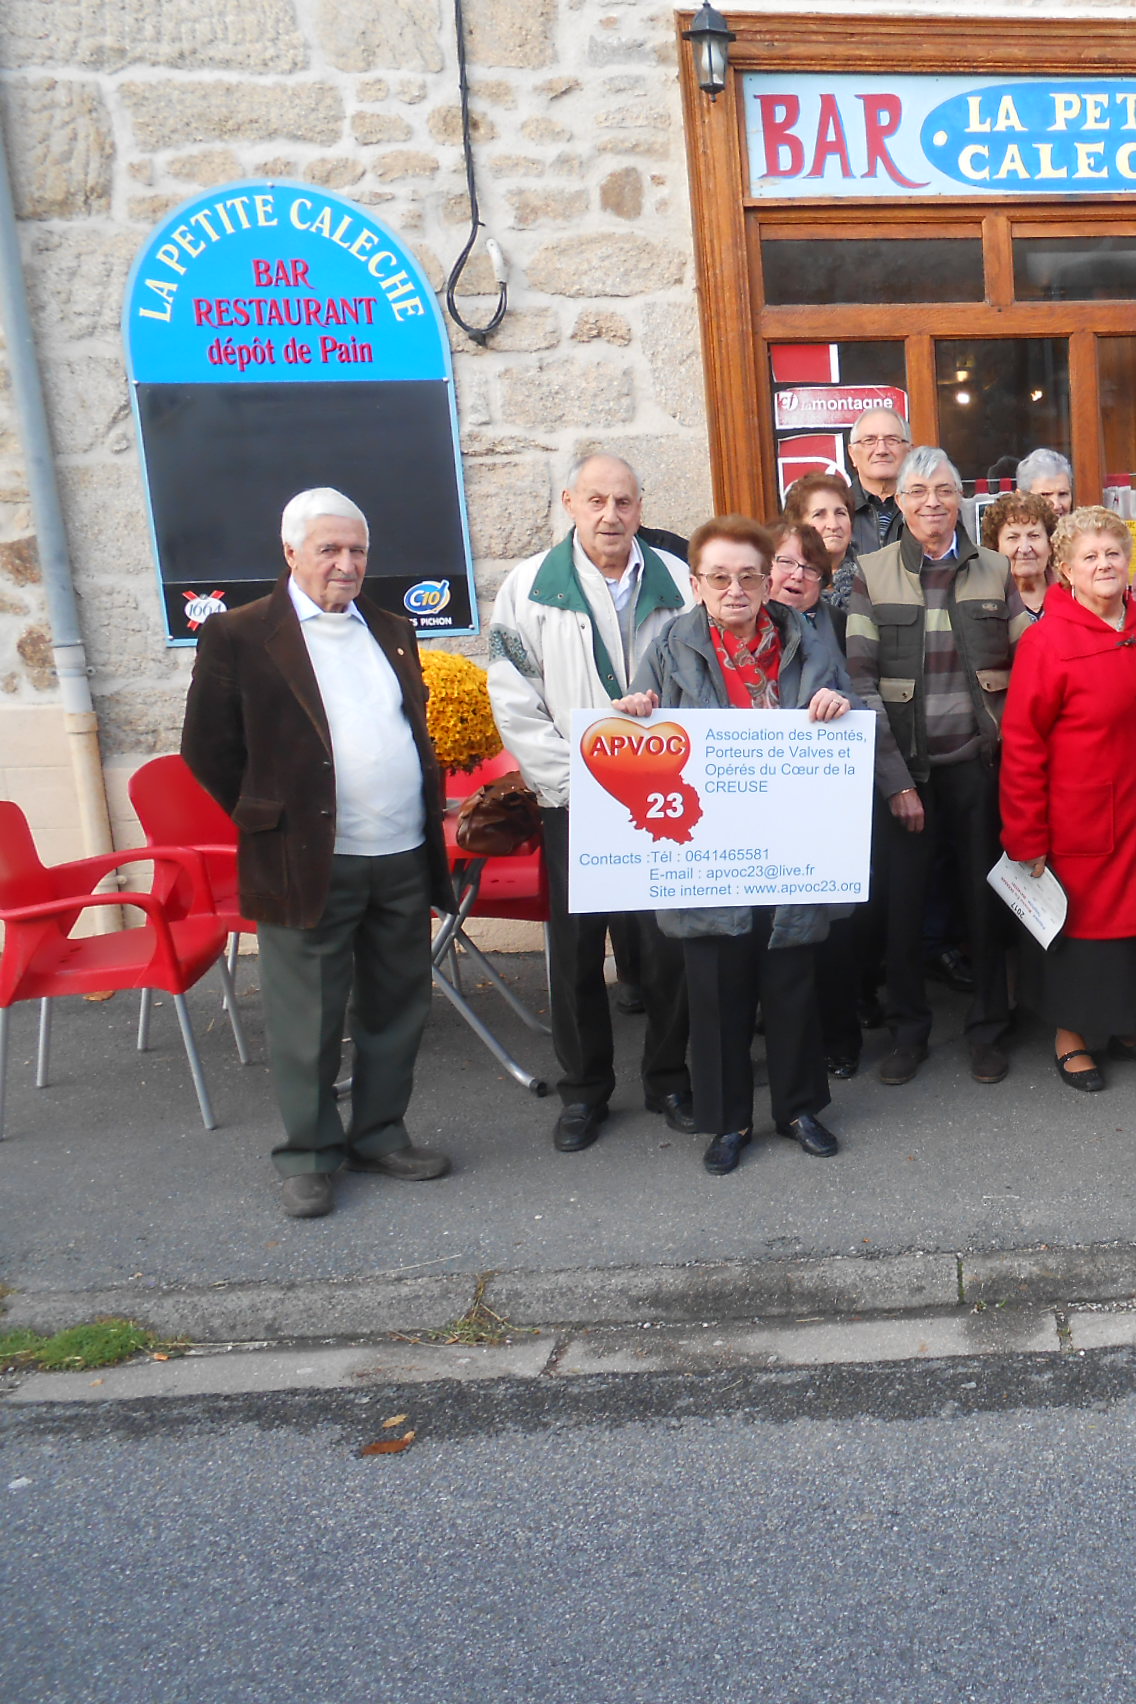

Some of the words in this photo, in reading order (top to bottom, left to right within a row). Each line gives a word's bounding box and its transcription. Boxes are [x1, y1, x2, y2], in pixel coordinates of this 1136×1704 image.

[964, 95, 1028, 133] LA
[753, 93, 931, 189] BAR
[155, 195, 279, 276] PETITE
[289, 198, 425, 322] CALECHE
[252, 258, 316, 289] BAR
[139, 278, 179, 323] LA
[193, 297, 377, 329] RESTAURANT
[207, 336, 276, 372] dépôt
[283, 337, 312, 364] de
[319, 335, 373, 364] Pain
[409, 590, 441, 607] C10
[420, 617, 452, 627] PICHON
[589, 734, 686, 757] APVOC
[705, 728, 784, 741] Association
[788, 729, 813, 741] des
[817, 728, 867, 743] Pontés,
[705, 746, 764, 758] Porteurs
[768, 746, 785, 758] de
[789, 746, 834, 758] Valves
[838, 747, 851, 758] et
[705, 763, 756, 778] Opérés
[760, 763, 776, 776] du
[781, 763, 819, 776] Cœur
[823, 763, 840, 776] de
[844, 763, 855, 776] la
[704, 780, 768, 793] CREUSE
[646, 792, 684, 818] 23
[579, 852, 642, 865] Contacts
[685, 848, 769, 862] 0641465581
[649, 867, 693, 880] E-mail
[706, 864, 815, 881] apvoc23@live.fr
[649, 885, 676, 898] Site
[681, 884, 731, 897] internet
[744, 880, 861, 895] www.apvoc23.org
